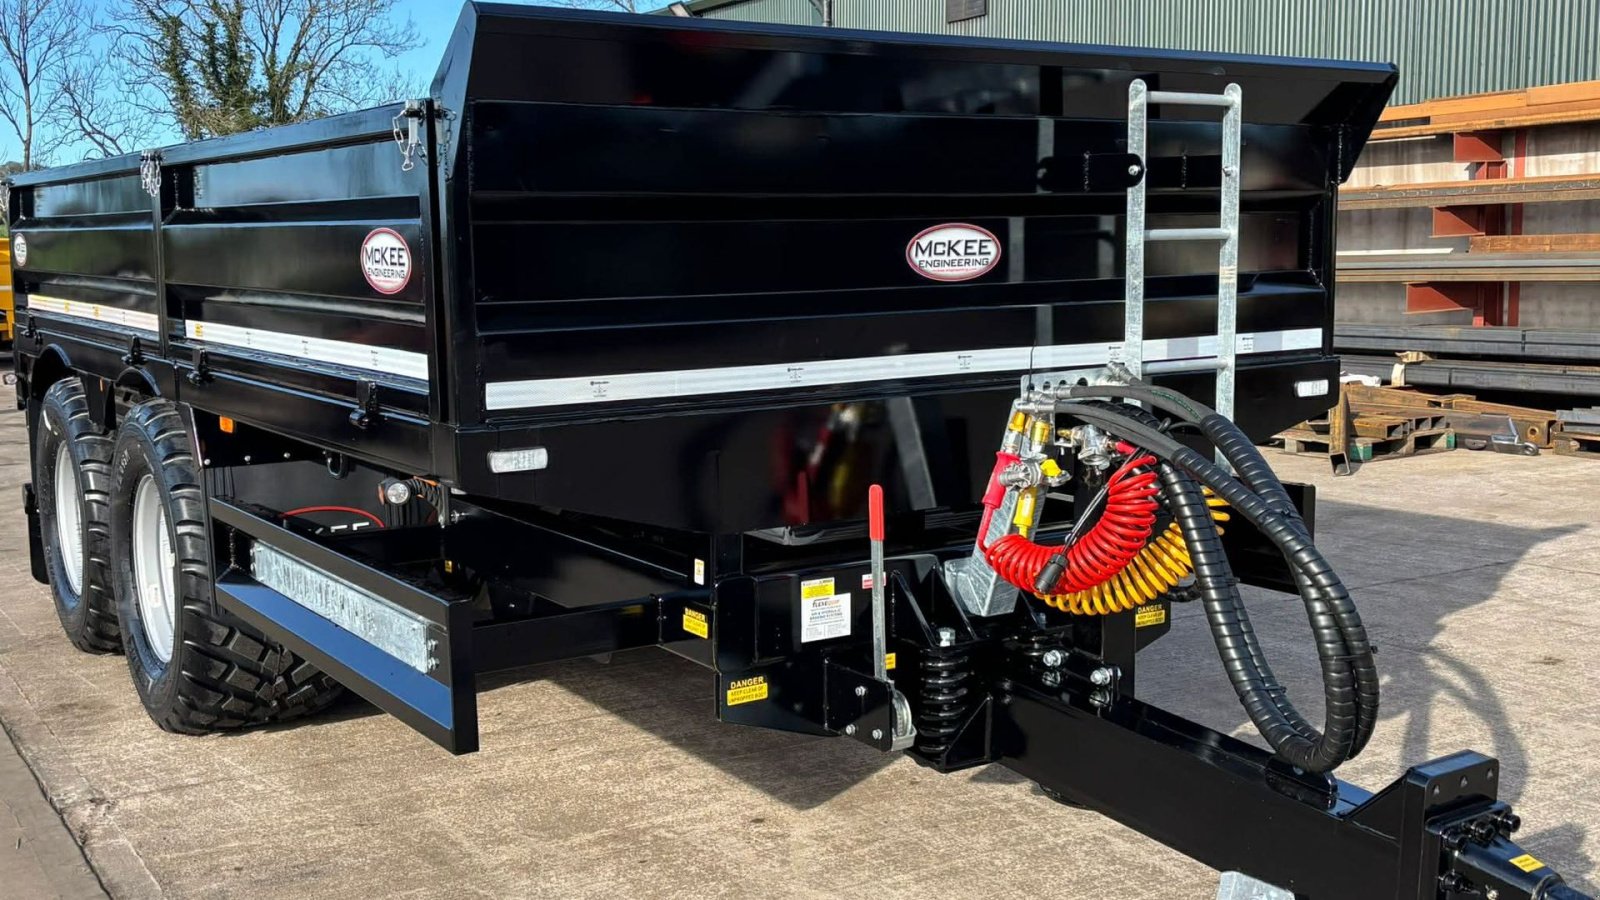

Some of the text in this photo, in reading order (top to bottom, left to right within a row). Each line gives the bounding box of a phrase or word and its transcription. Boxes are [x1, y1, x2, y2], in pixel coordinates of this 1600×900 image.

[918, 258, 989, 269] ENGINEERING
[367, 267, 405, 279] ENGINEERING
[1137, 604, 1163, 614] DANGER
[730, 676, 764, 689] DANGER
